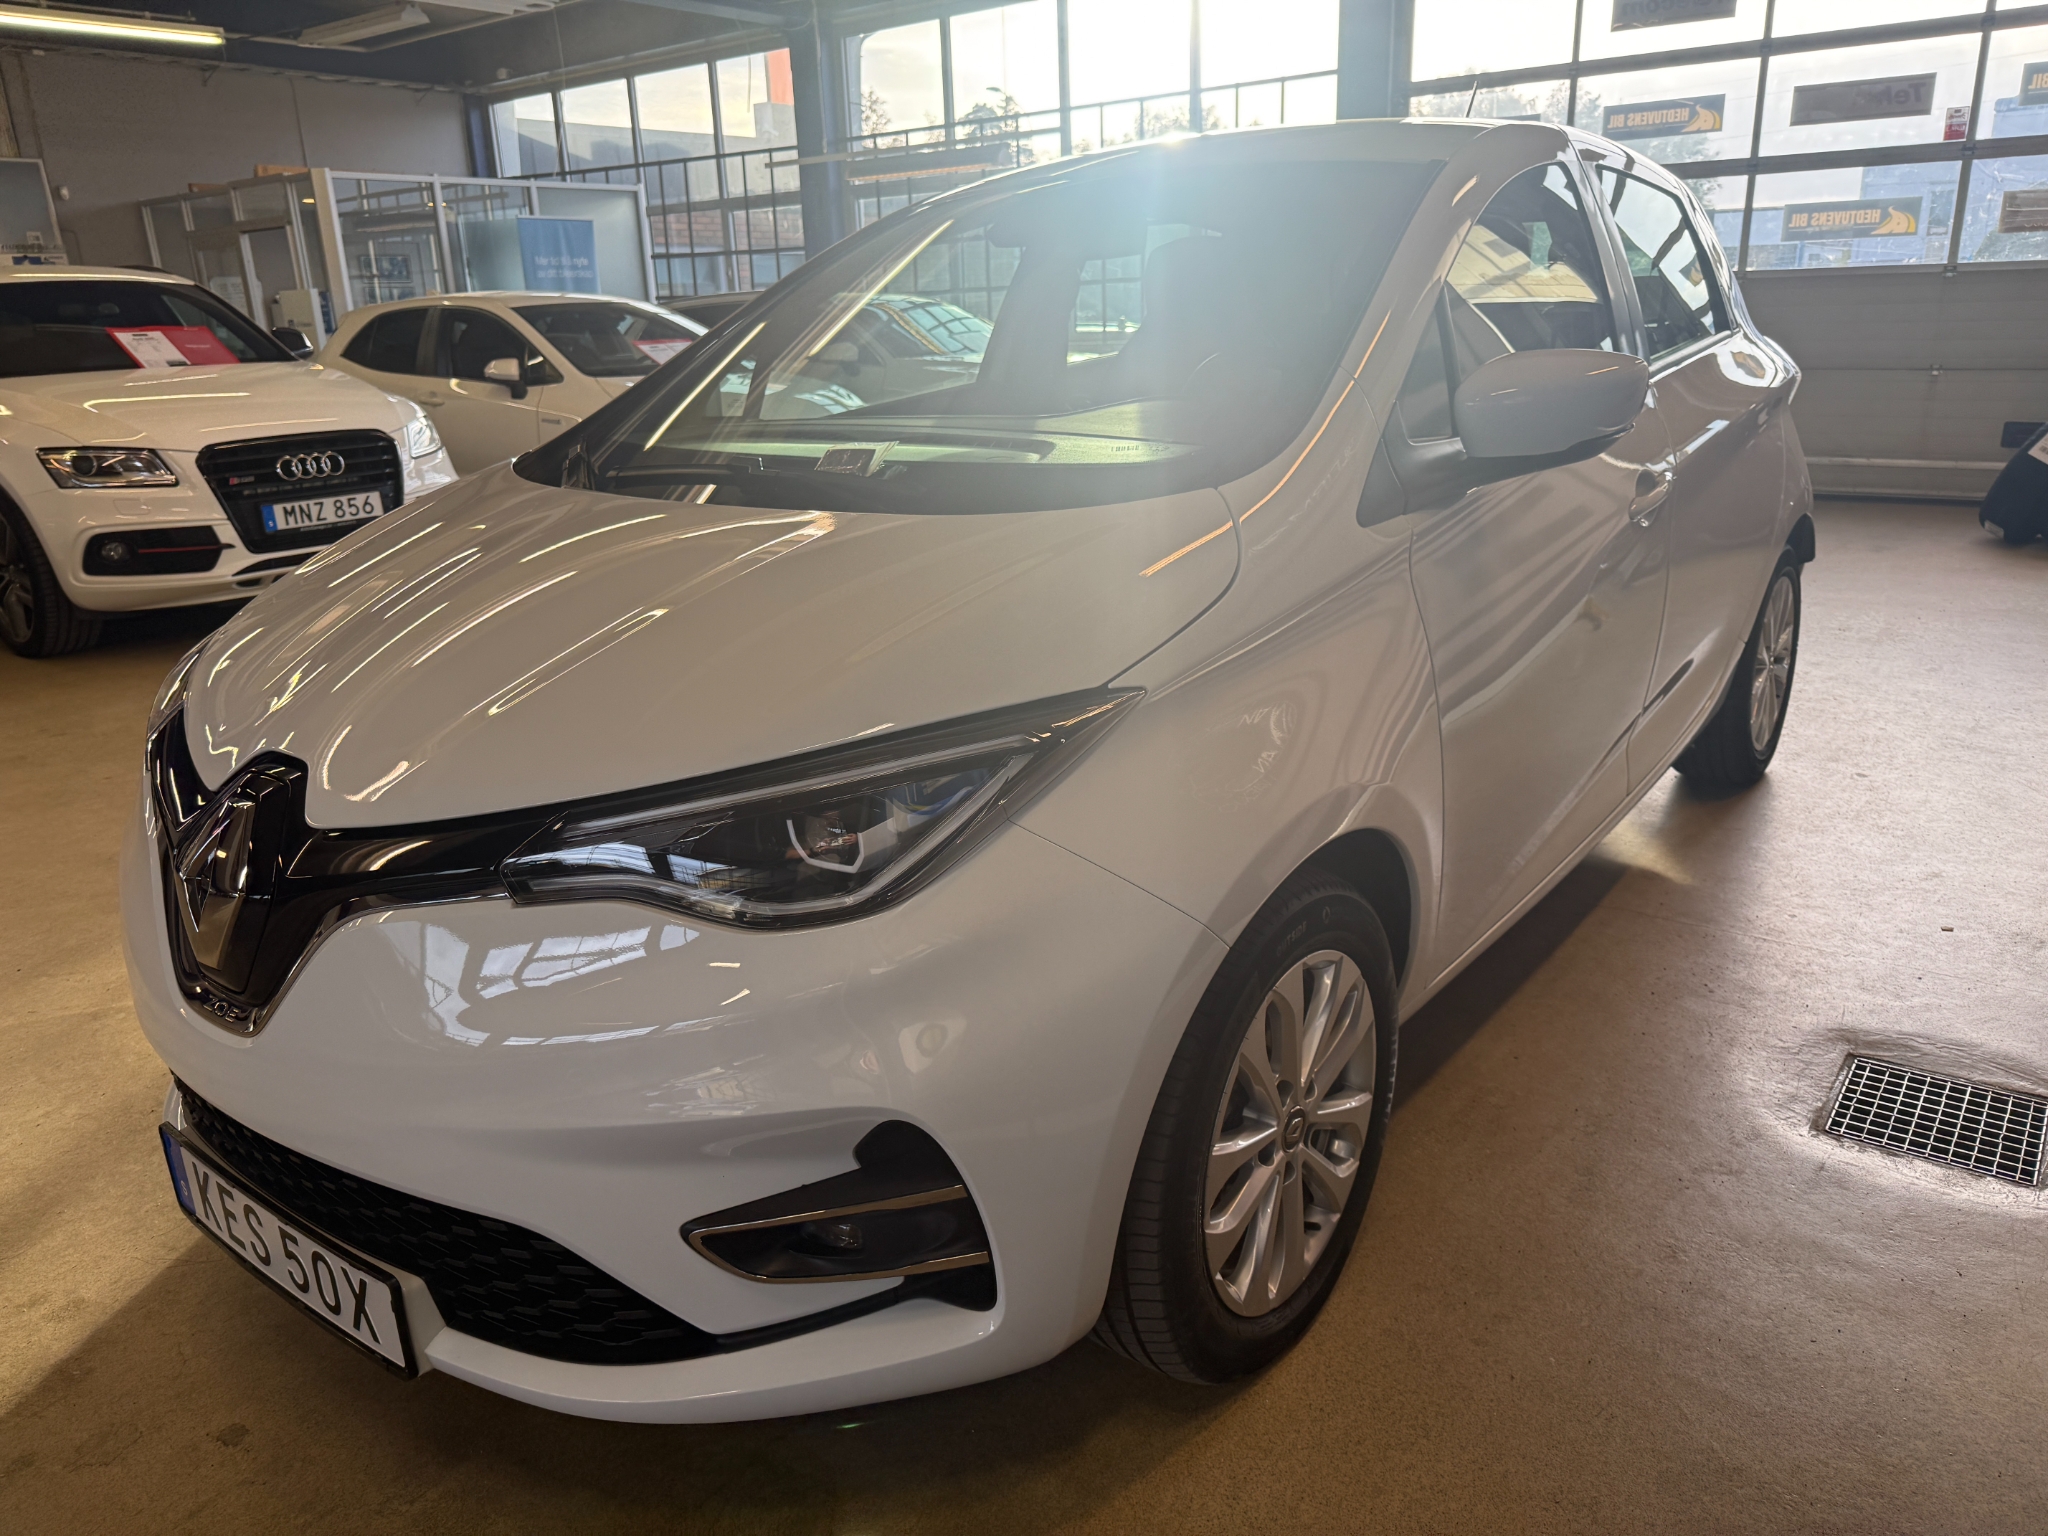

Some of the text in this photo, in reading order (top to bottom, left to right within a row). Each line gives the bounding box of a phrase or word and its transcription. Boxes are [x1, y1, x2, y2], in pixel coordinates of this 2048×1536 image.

[283, 501, 327, 526] MNZ
[333, 495, 375, 518] 856
[203, 994, 239, 1023] ZOE
[180, 1161, 382, 1345] S KES 50X
